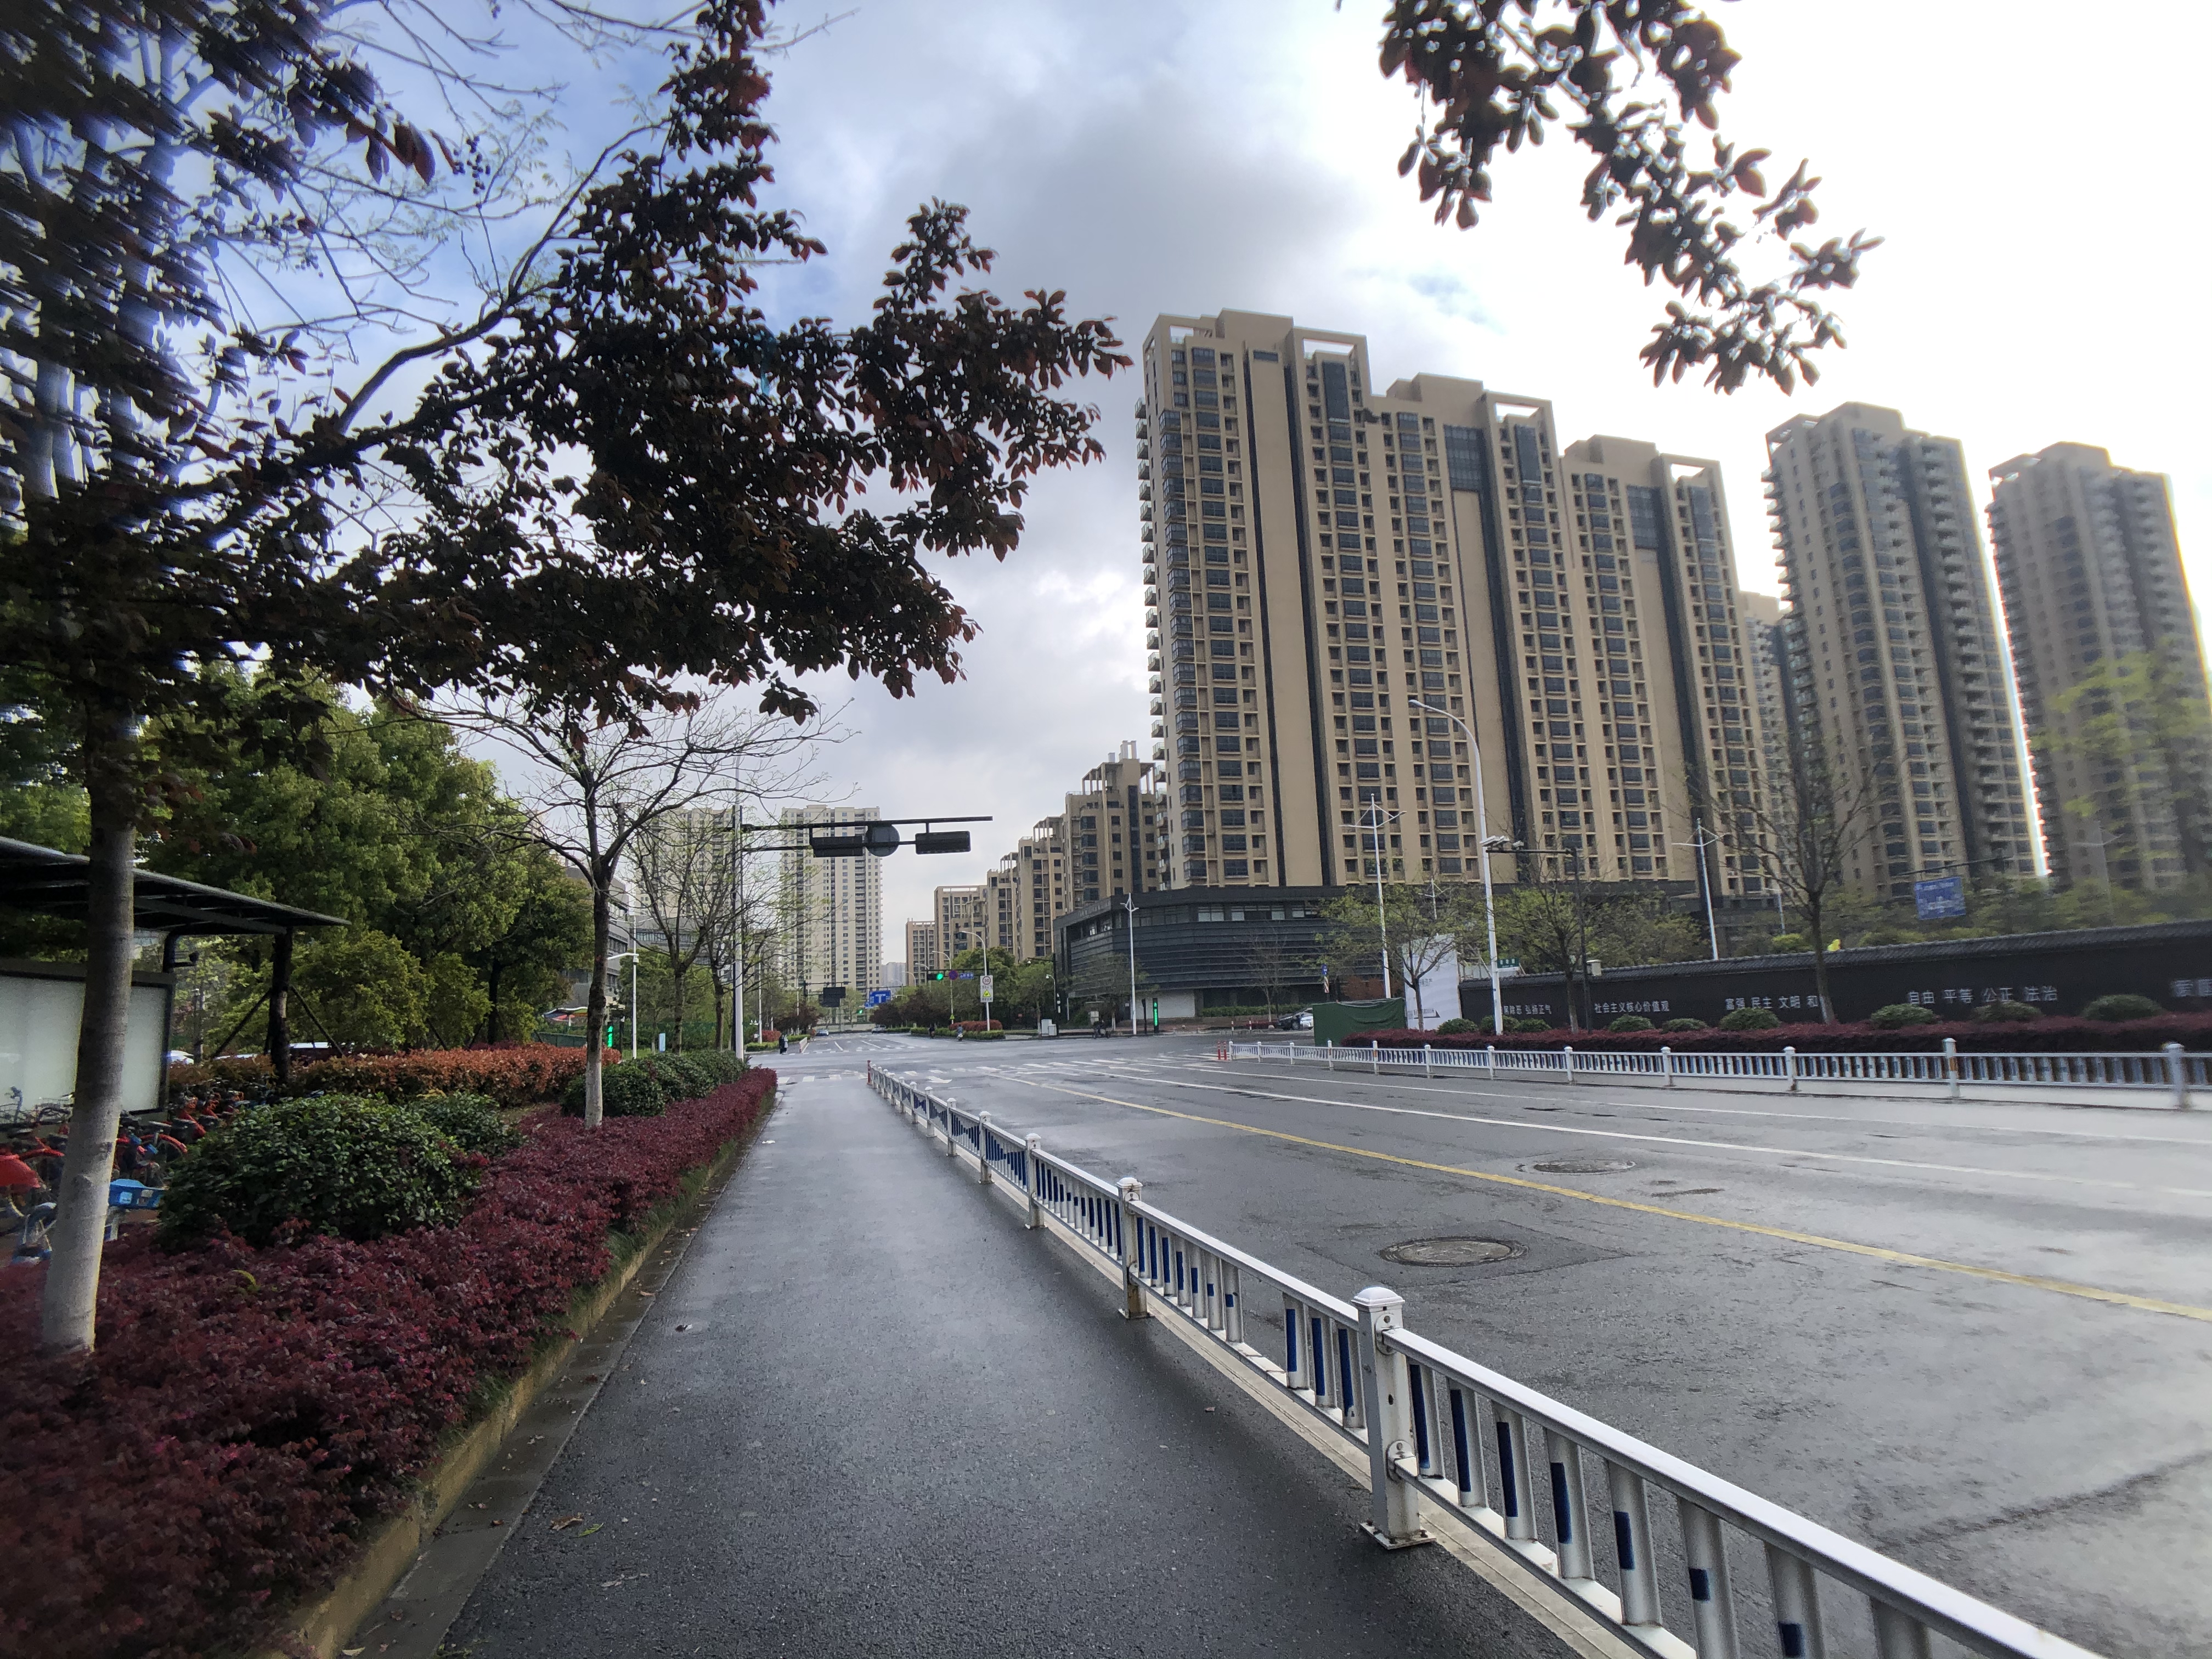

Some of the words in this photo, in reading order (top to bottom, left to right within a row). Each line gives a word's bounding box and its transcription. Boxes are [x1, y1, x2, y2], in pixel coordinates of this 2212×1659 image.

[1751, 996, 1772, 1009] 民主
[1909, 990, 1934, 1005] 自由
[1983, 988, 2013, 1002] 公正
[1502, 1005, 1522, 1015] 黑除恶
[1594, 1001, 1670, 1013] 社会主义核心价值观
